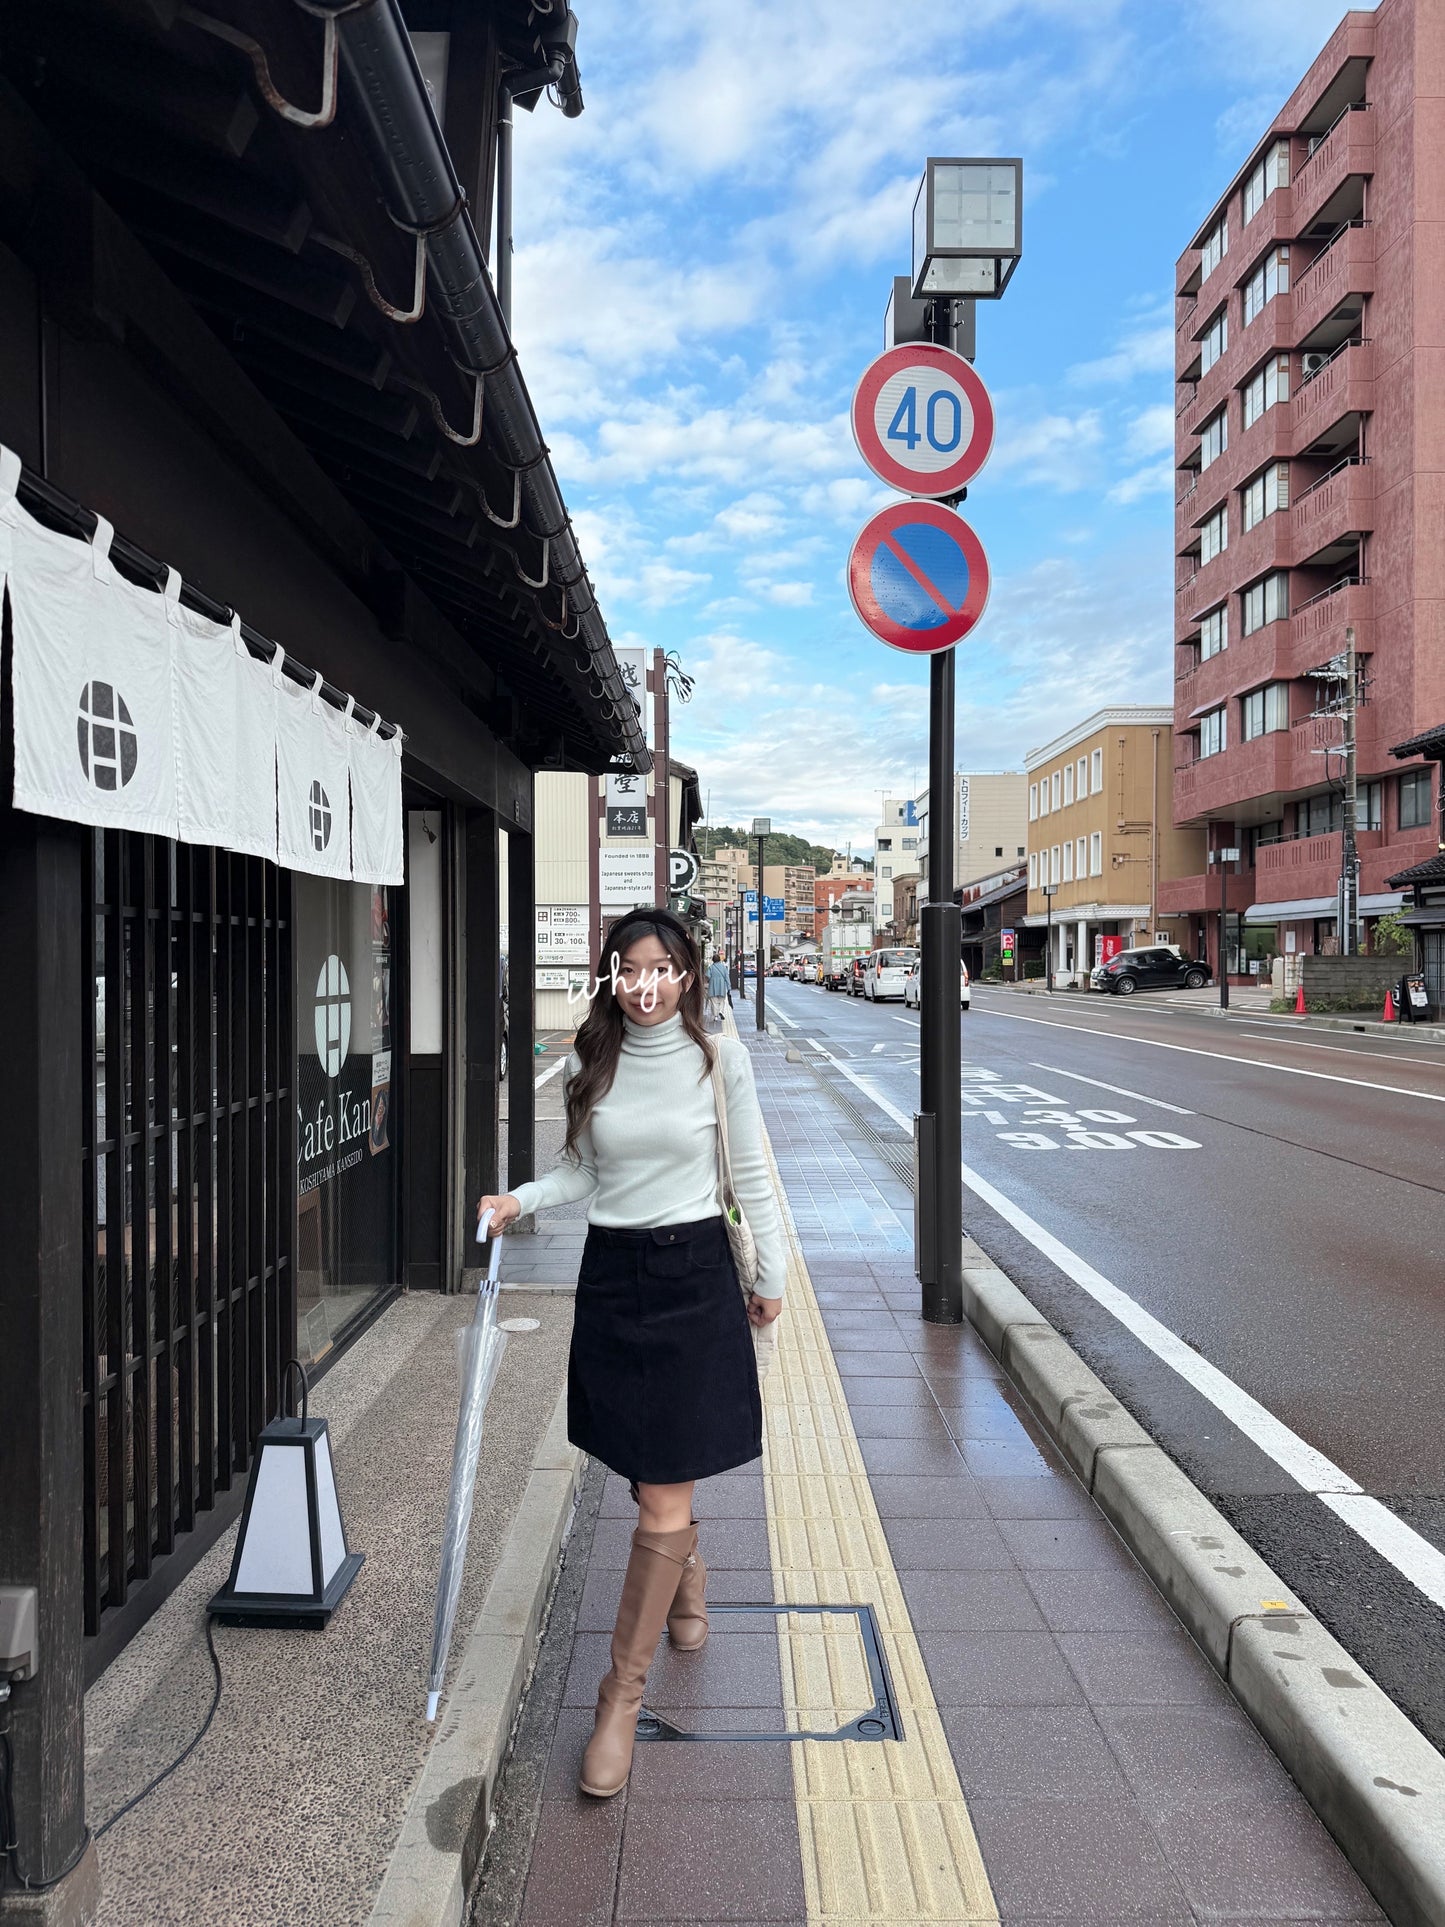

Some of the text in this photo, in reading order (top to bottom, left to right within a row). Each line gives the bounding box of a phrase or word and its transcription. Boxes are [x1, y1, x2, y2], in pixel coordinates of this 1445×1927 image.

[887, 386, 961, 453] 40
[613, 810, 639, 824] 本店
[961, 778, 969, 839] トロフィー・カップ
[670, 857, 689, 885] P
[339, 1090, 372, 1144] Kan
[336, 1148, 363, 1176] KANSEIDO
